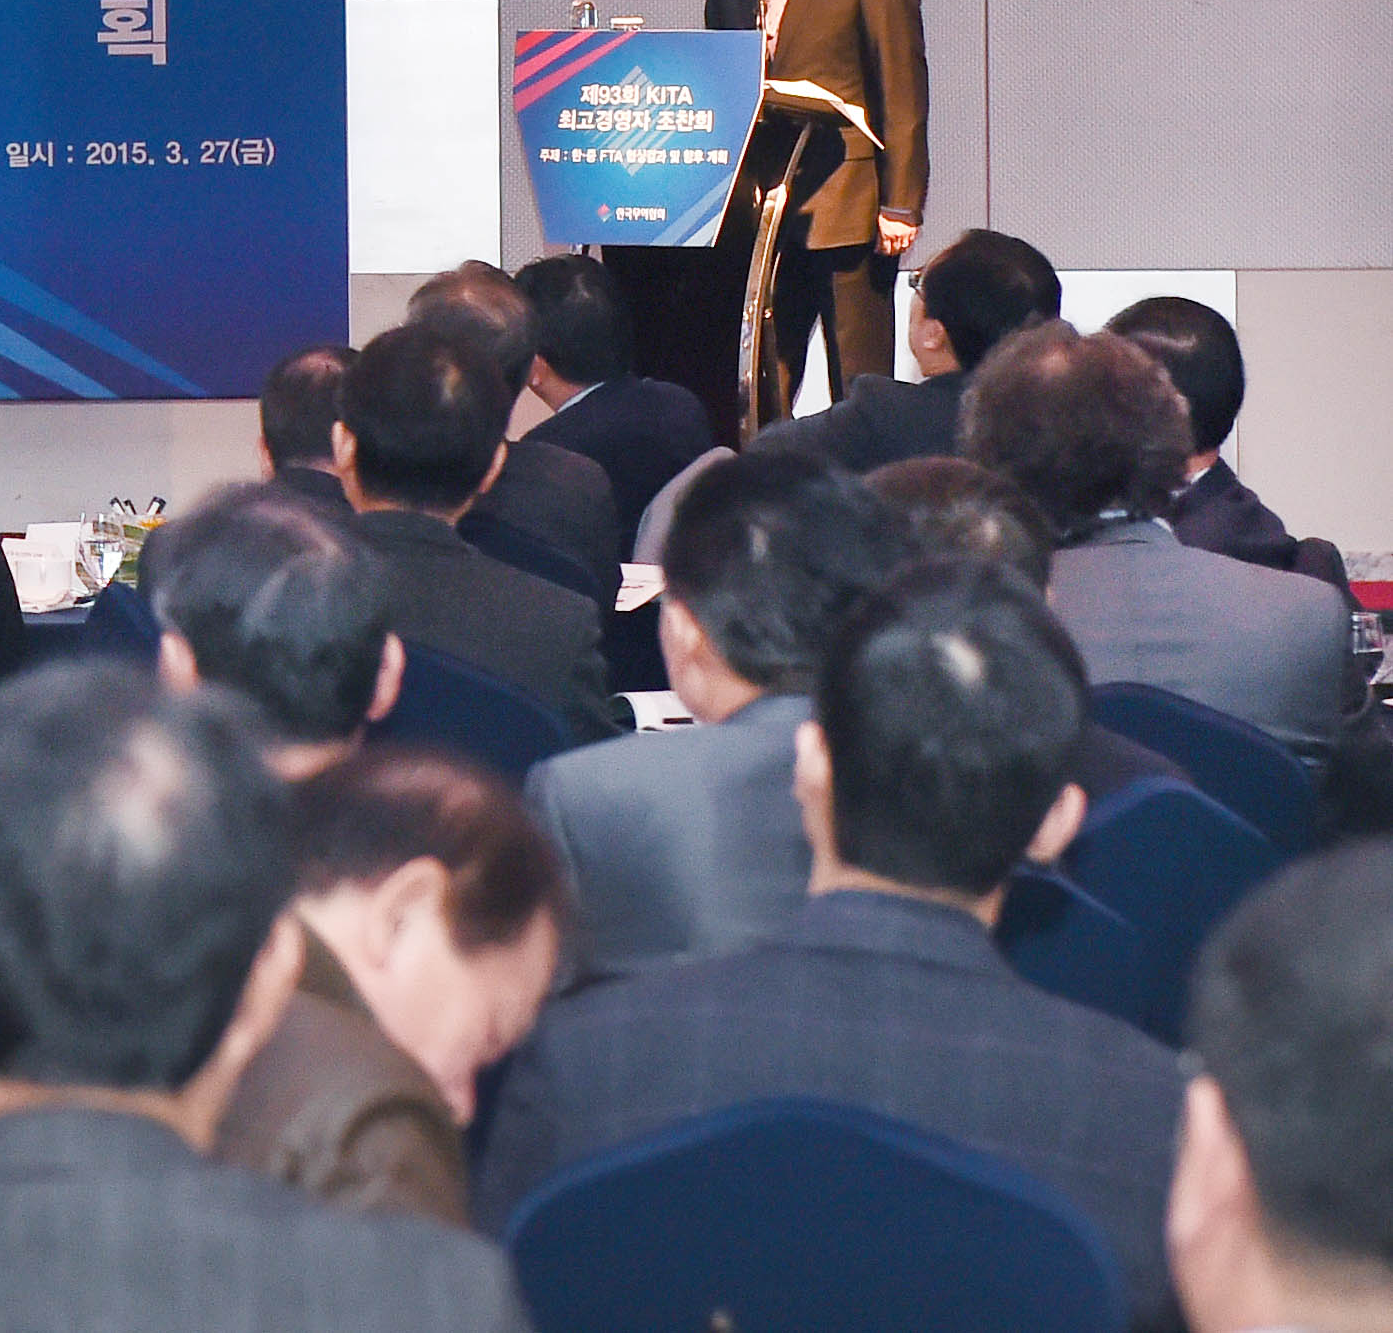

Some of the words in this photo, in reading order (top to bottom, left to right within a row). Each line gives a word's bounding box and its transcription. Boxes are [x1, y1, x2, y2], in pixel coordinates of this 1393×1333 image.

[580, 84, 640, 106] 제93회
[646, 85, 693, 105] KITA
[558, 110, 651, 132] 최고경영자
[656, 109, 713, 132] 조찬회
[6, 142, 53, 167] 일시
[86, 142, 154, 165] 2015.
[166, 141, 189, 164] 3.
[201, 138, 274, 166] 27(금)
[600, 150, 623, 162] FTA
